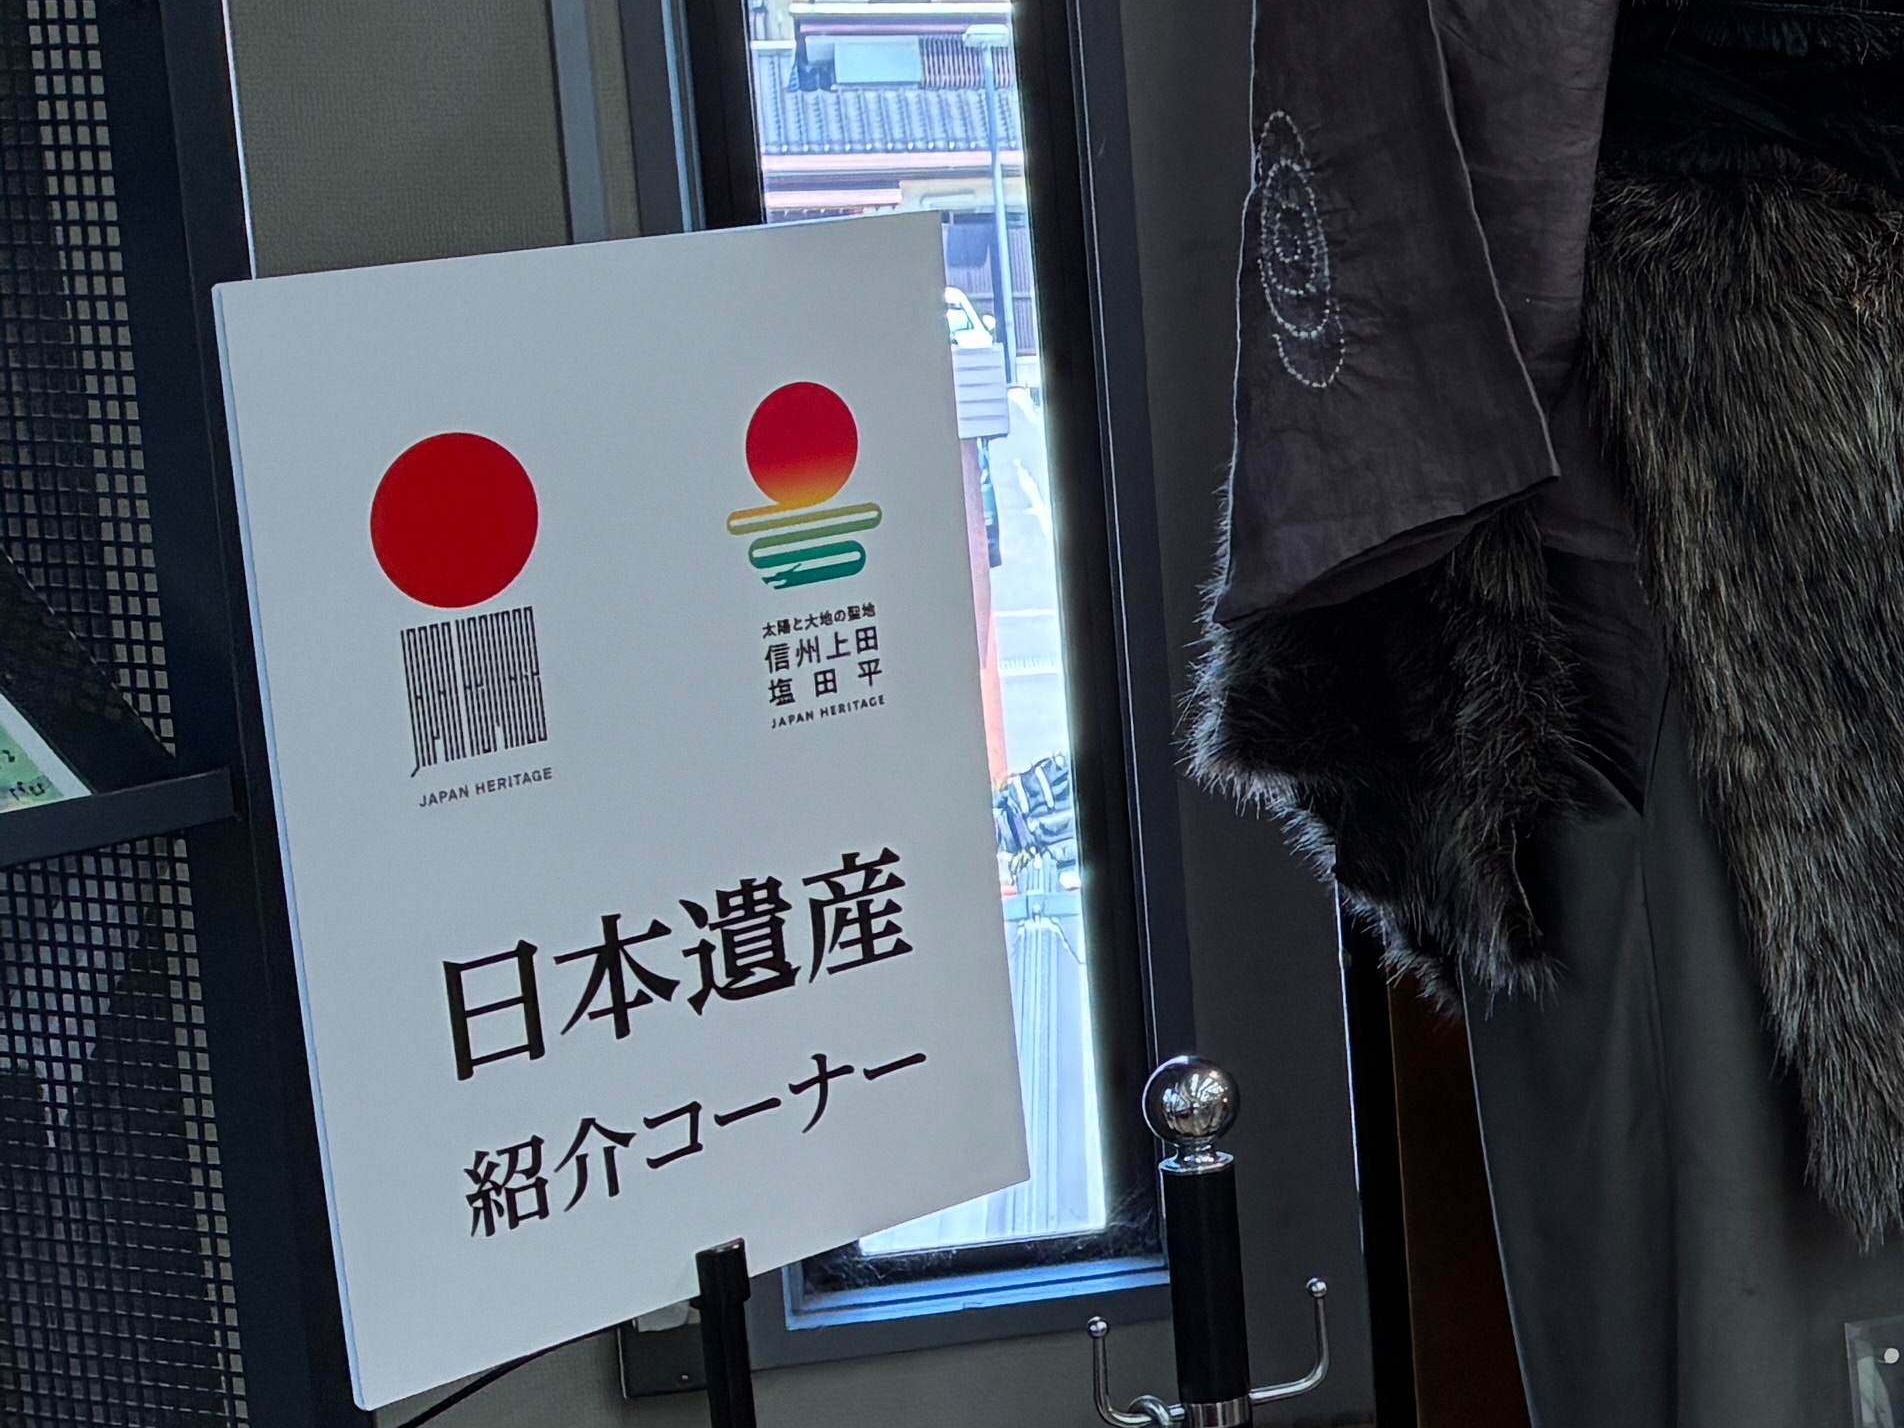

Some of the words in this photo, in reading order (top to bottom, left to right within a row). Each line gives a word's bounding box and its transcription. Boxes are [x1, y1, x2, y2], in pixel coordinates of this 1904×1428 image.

[762, 602, 877, 640] 太陽と大地の聖地
[765, 626, 880, 674] 信州上田
[771, 710, 815, 730] JAPAN
[820, 694, 886, 720] HERITAGE
[419, 784, 470, 808] JAPAN
[475, 767, 553, 796] HERITAGE
[442, 846, 914, 1081] 日本遺産
[463, 1052, 928, 1237] 紹介コーナー
